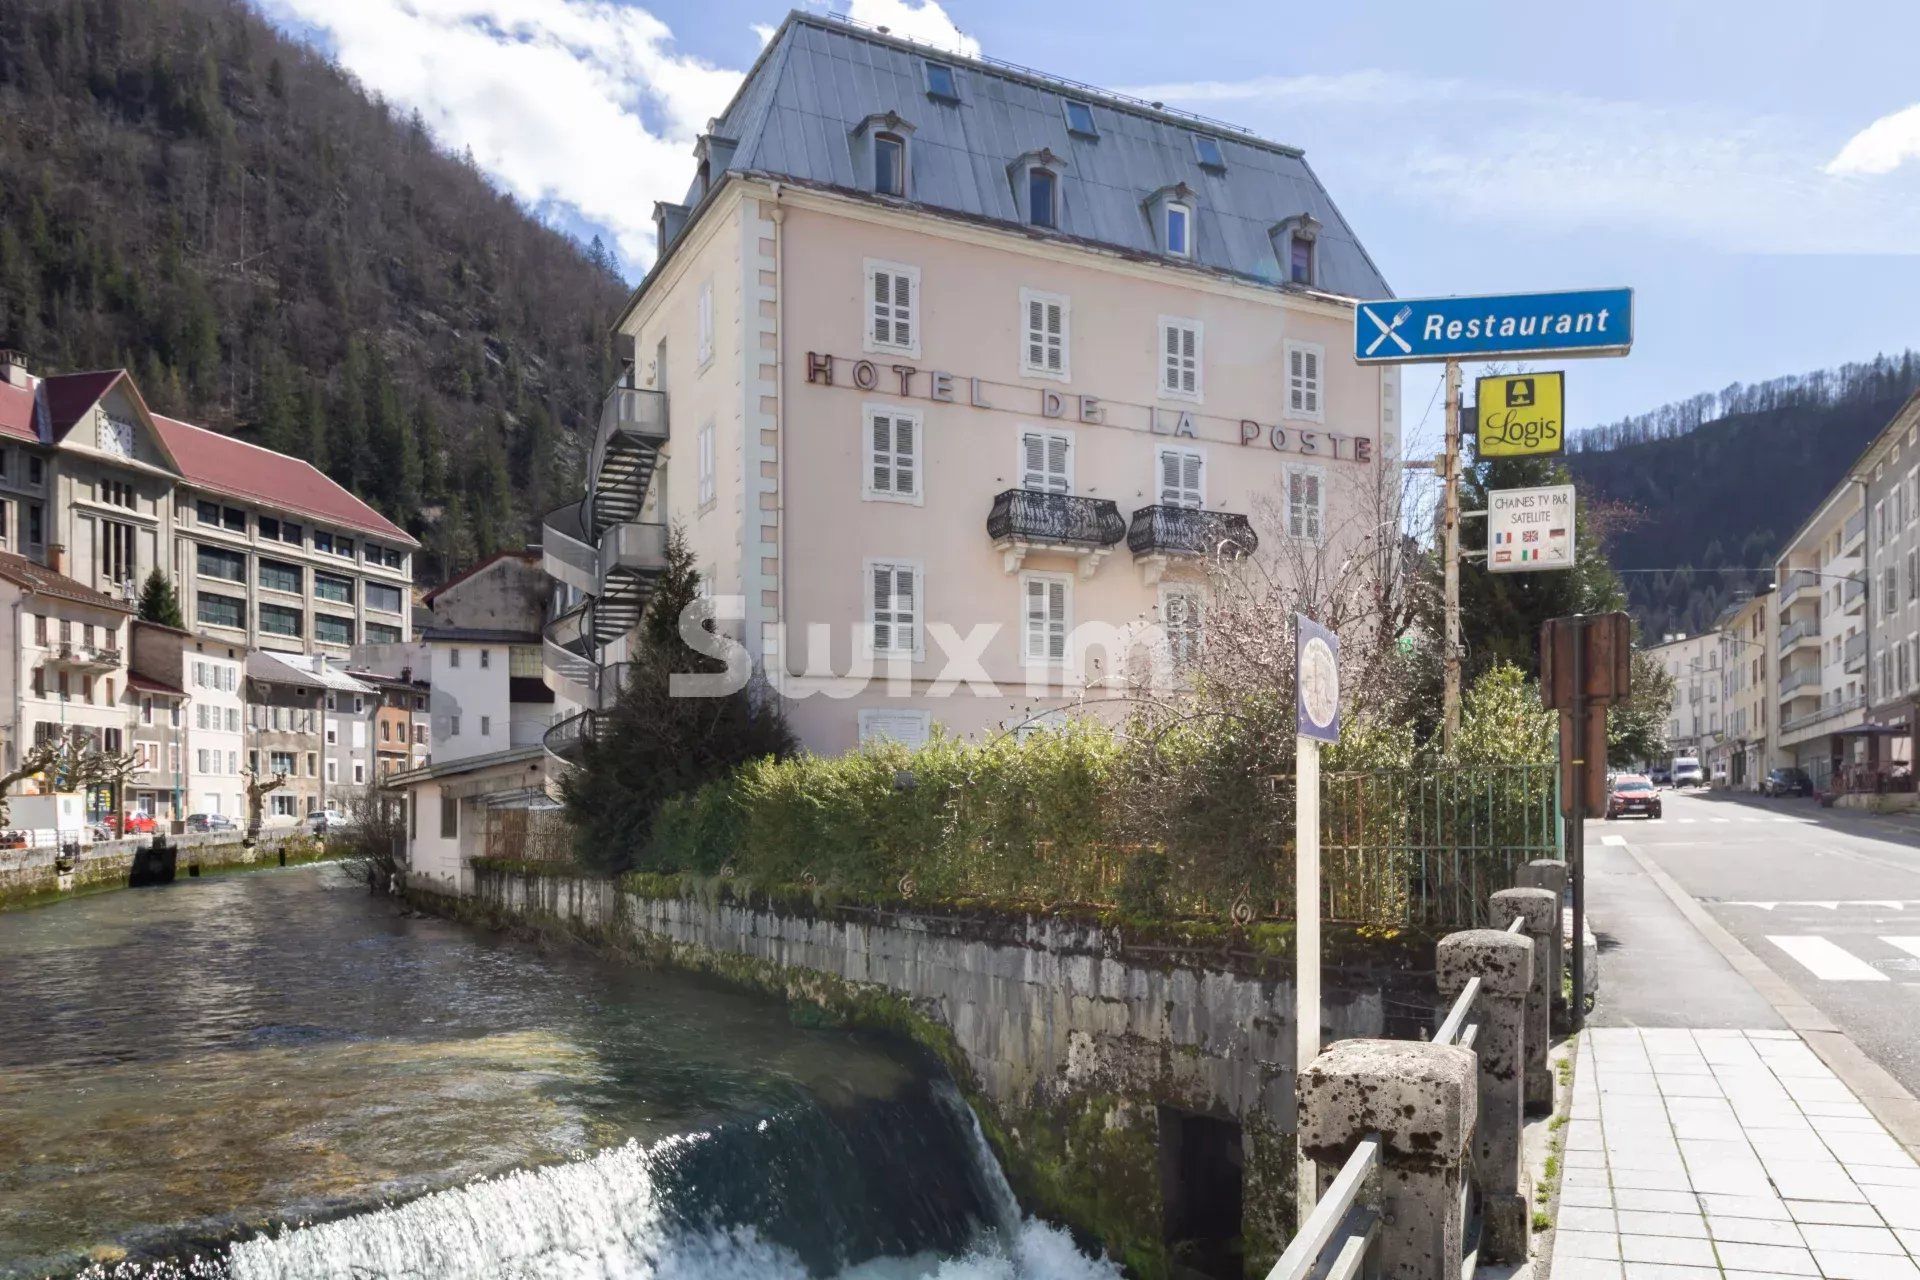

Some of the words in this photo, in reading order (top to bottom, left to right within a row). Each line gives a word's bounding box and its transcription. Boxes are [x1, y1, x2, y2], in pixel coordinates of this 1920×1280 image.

[1424, 308, 1609, 340] Restaurant
[808, 351, 991, 409] HOTEL
[1042, 388, 1103, 424] DE
[1150, 406, 1198, 439] LA
[1240, 419, 1371, 463] POSTE
[1483, 409, 1557, 448] Logis
[1538, 494, 1550, 507] TV
[1552, 493, 1569, 506] PAR
[1511, 511, 1551, 524] SATELLITE
